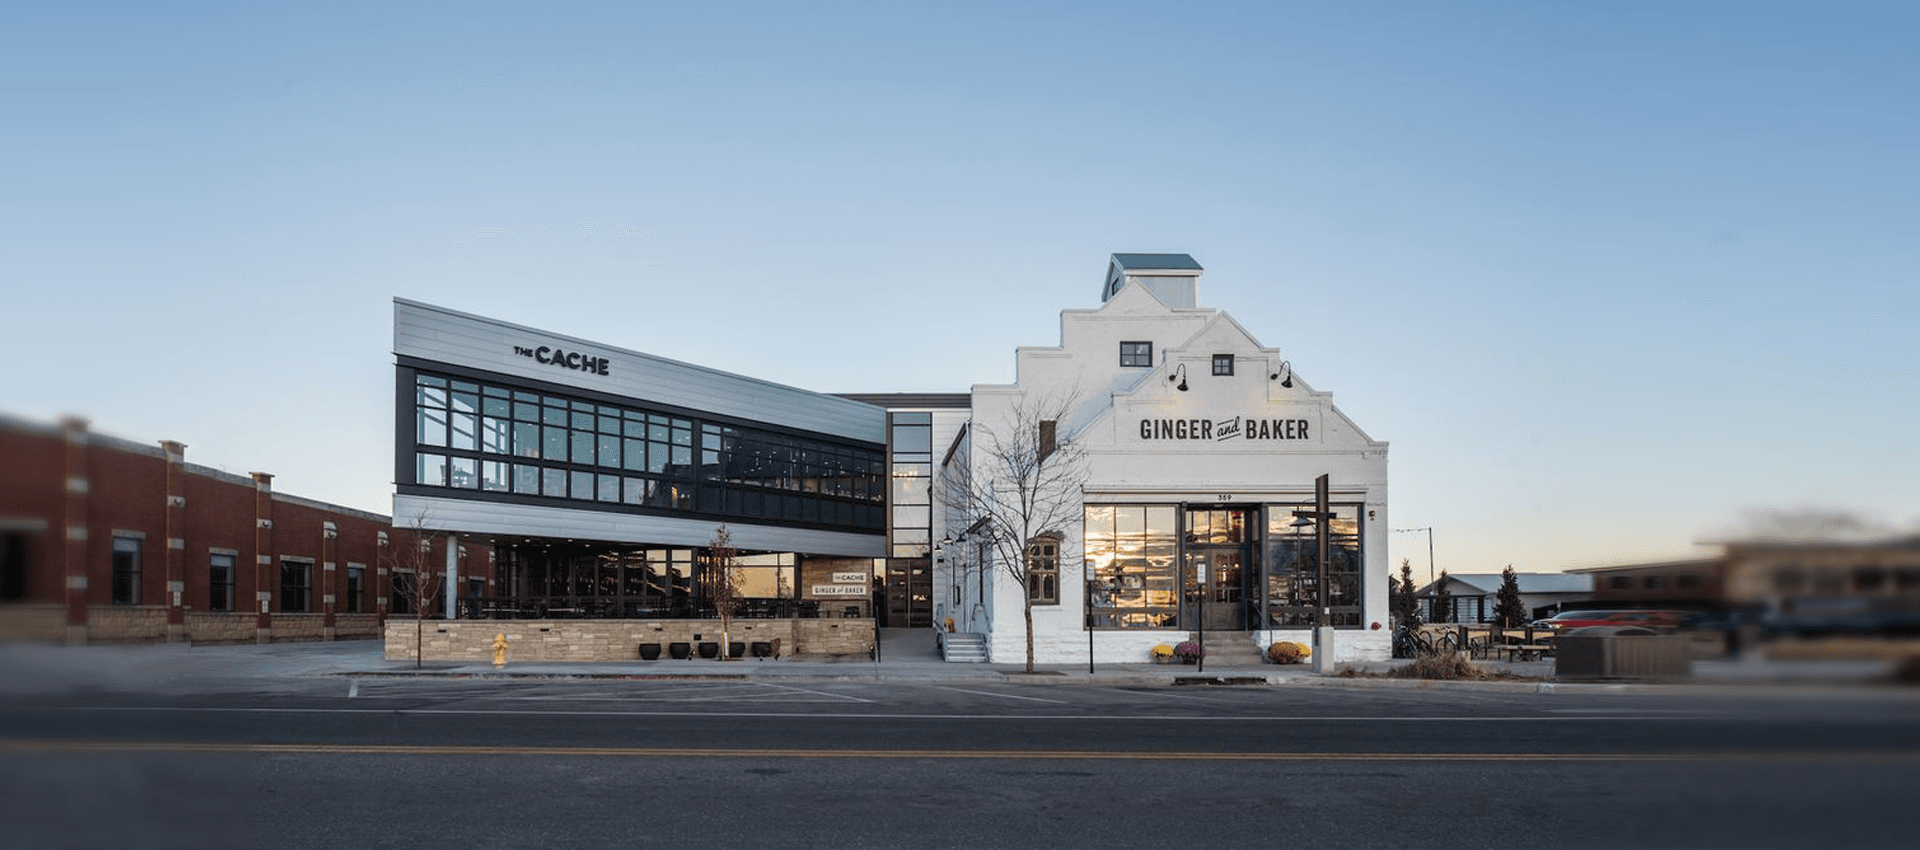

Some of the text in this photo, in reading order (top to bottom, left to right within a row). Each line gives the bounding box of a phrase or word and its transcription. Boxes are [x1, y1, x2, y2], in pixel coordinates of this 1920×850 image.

[514, 346, 609, 376] THE CACHE
[1140, 416, 1309, 440] GINGER and BAKER
